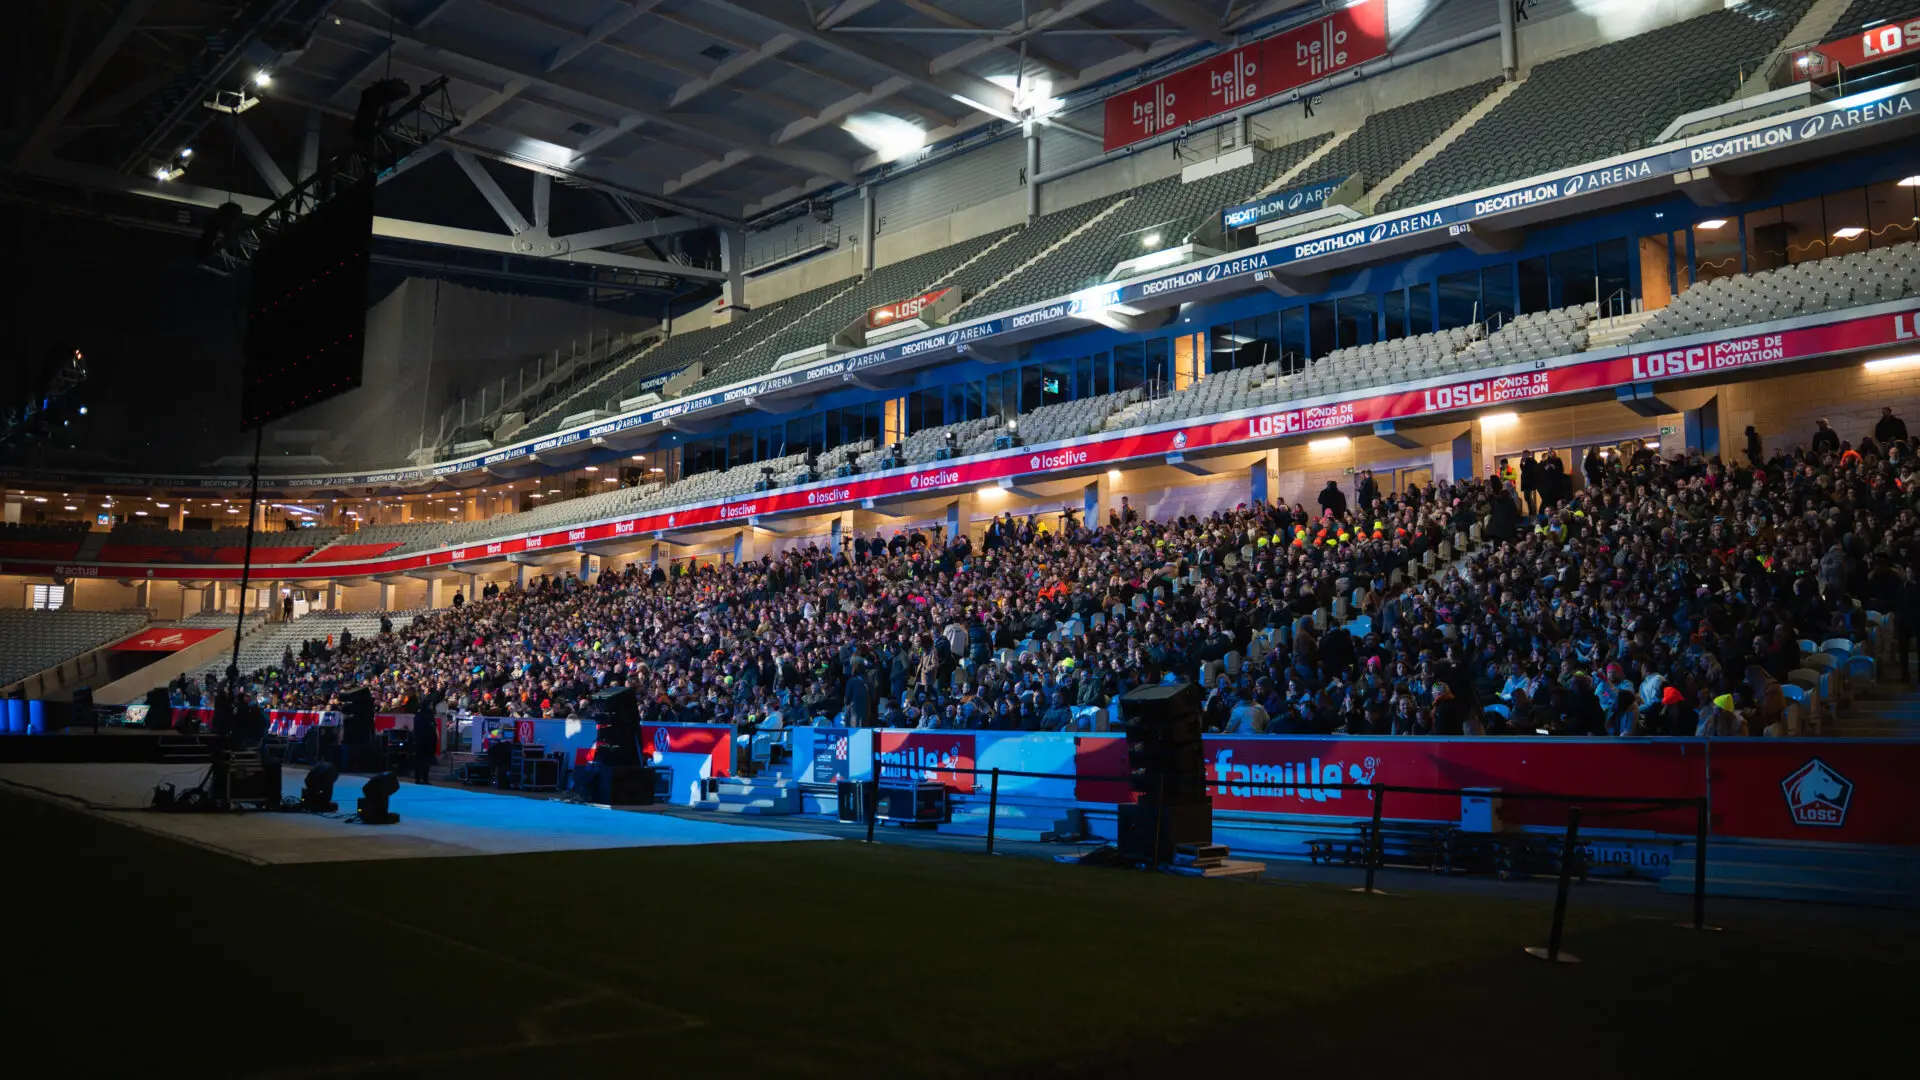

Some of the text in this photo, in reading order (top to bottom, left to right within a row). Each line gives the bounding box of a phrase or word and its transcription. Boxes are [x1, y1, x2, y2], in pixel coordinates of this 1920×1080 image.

[1296, 19, 1347, 62] hello
[1211, 51, 1257, 95] hello
[1310, 48, 1348, 76] lille
[1133, 82, 1176, 120] hello
[1224, 80, 1257, 105] lille
[1144, 110, 1176, 134] lille
[1691, 96, 1912, 164] DECATHLON ARENA
[1475, 161, 1652, 215] DECATHLON ARENA
[1224, 200, 1284, 226] DECATHLON
[1295, 211, 1443, 258] DECATHLON ARENA
[1143, 254, 1268, 296] DECATHLON ARENA
[895, 298, 926, 319] LOSC
[1012, 305, 1063, 329] DECATHLON
[902, 323, 993, 356] DECATHLON ARENA
[806, 362, 844, 380] DECATHLON
[857, 351, 886, 367] ARENA
[1632, 347, 1705, 380] LOSC
[1765, 335, 1782, 349] DE
[1715, 345, 1783, 369] DOTATION
[724, 375, 793, 401] DECATHLON ARENA
[1424, 381, 1485, 411] LOSC
[1533, 372, 1548, 383] DE
[1493, 381, 1549, 401] DOTATION
[690, 396, 713, 411] ARENA
[589, 415, 642, 436] DECATHLON ARENA
[1249, 411, 1300, 438] LOSC
[1340, 403, 1353, 414] DE
[1307, 412, 1354, 429] DOTATION
[510, 447, 527, 458] ARENA
[533, 432, 581, 451] DECATHLON ARENA
[462, 460, 478, 470] ARENA
[1041, 450, 1087, 468] losclive
[920, 472, 959, 487] losclive
[816, 488, 850, 503] losclive
[728, 504, 756, 517] losclive
[569, 528, 585, 541] Nord
[616, 520, 634, 533] Nord
[487, 542, 502, 554] Nord
[526, 535, 541, 547] Nord
[451, 549, 465, 559] Nord
[1215, 749, 1343, 803] famille
[1800, 808, 1837, 821] LOSC
[1604, 849, 1631, 865] L03
[1641, 851, 1670, 867] L04
